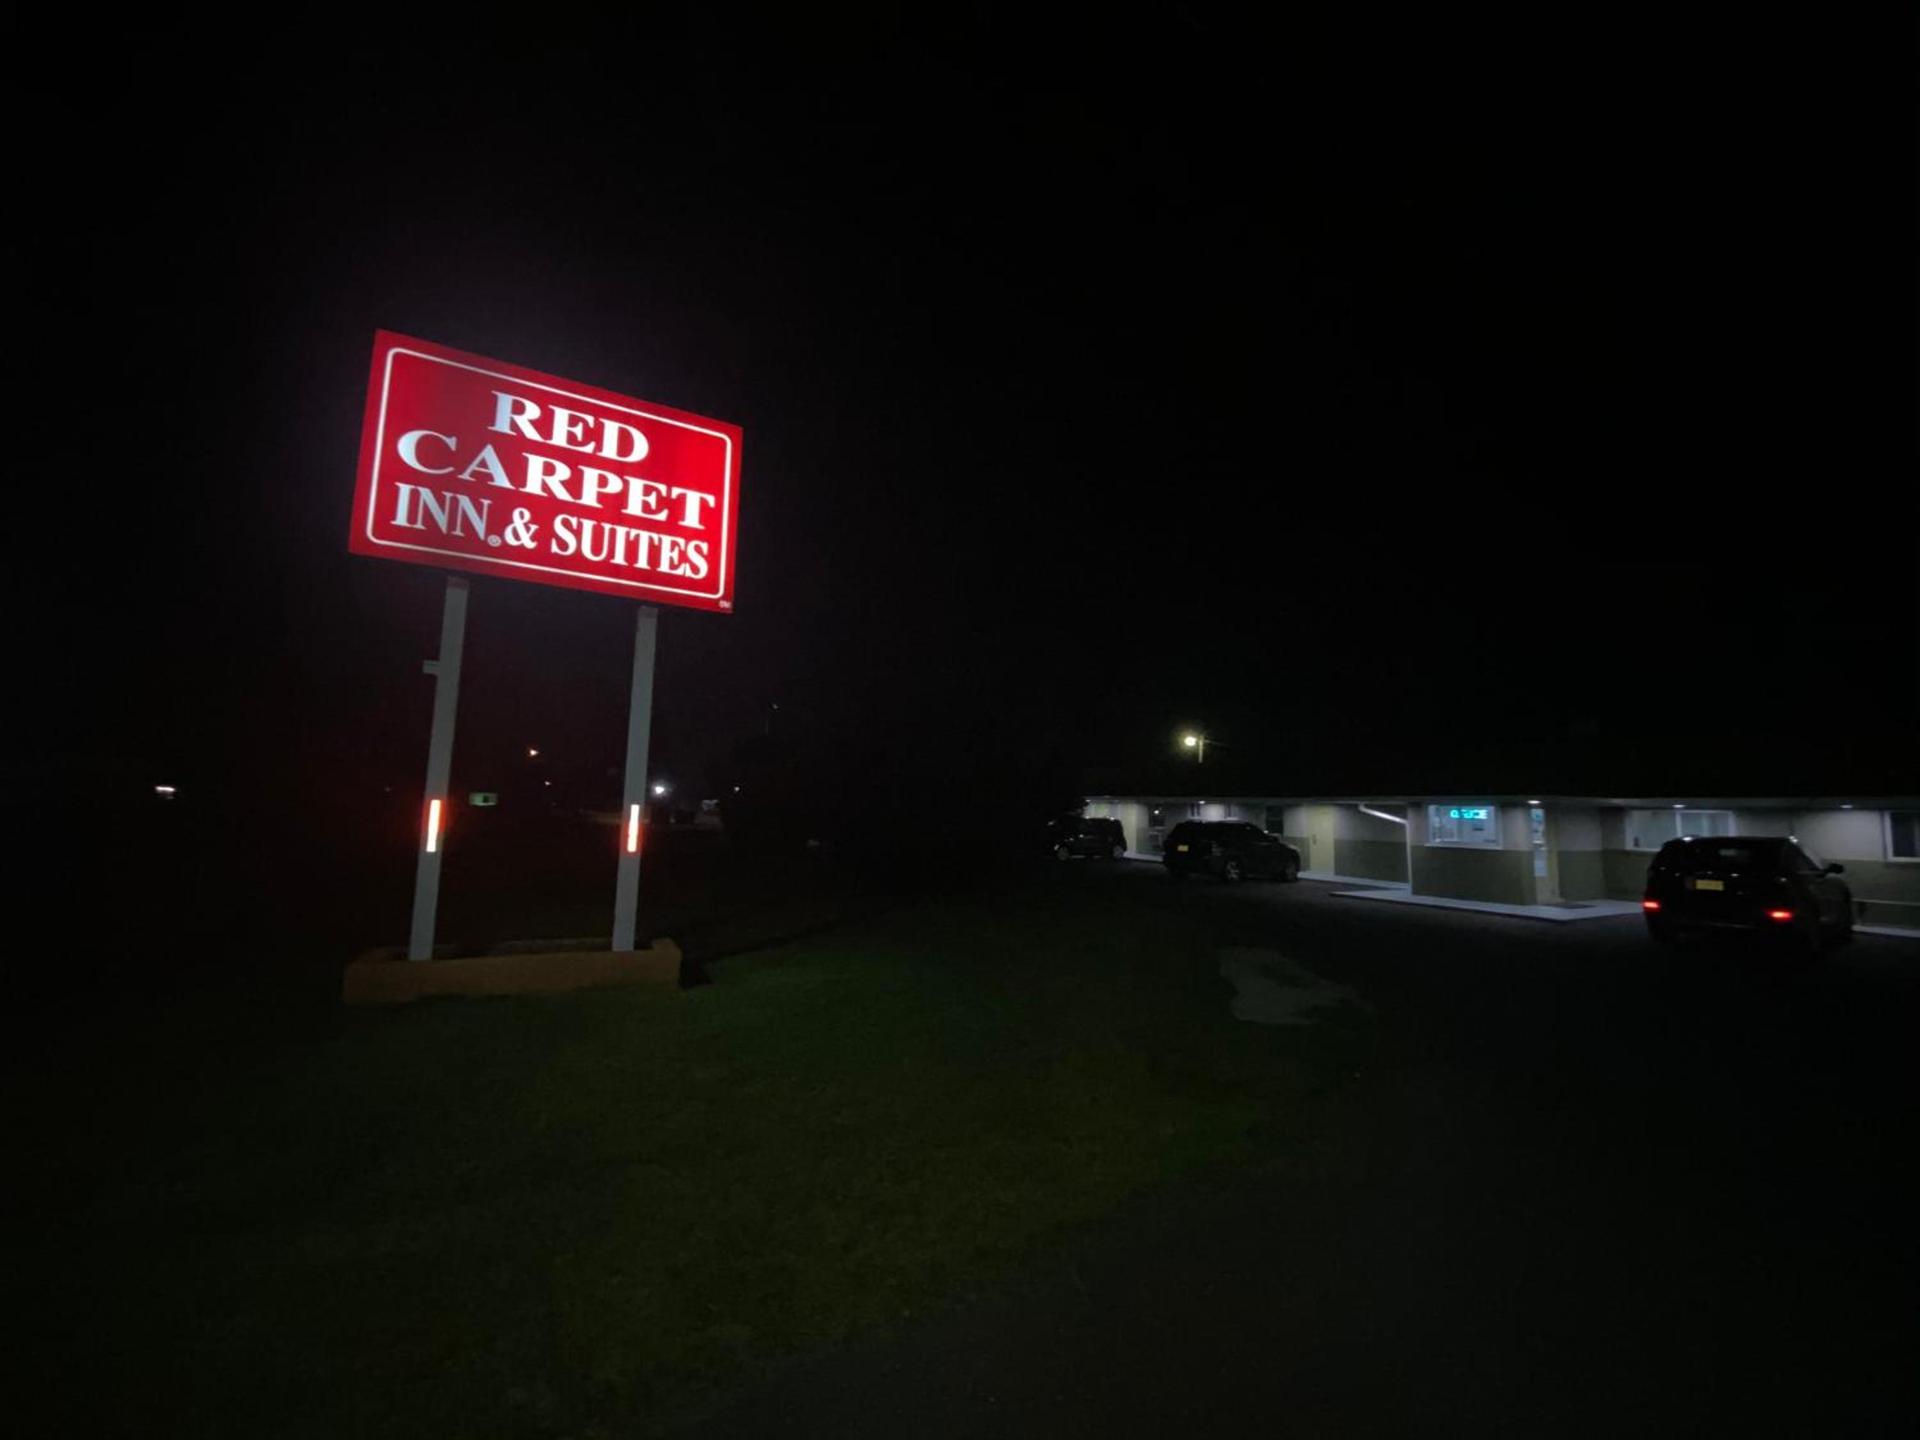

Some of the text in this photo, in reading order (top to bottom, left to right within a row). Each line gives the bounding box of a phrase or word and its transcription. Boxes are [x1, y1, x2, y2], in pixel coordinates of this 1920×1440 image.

[488, 390, 650, 463] RED
[396, 429, 715, 530] CARPET
[504, 507, 540, 549] &
[550, 513, 709, 579] SUITES
